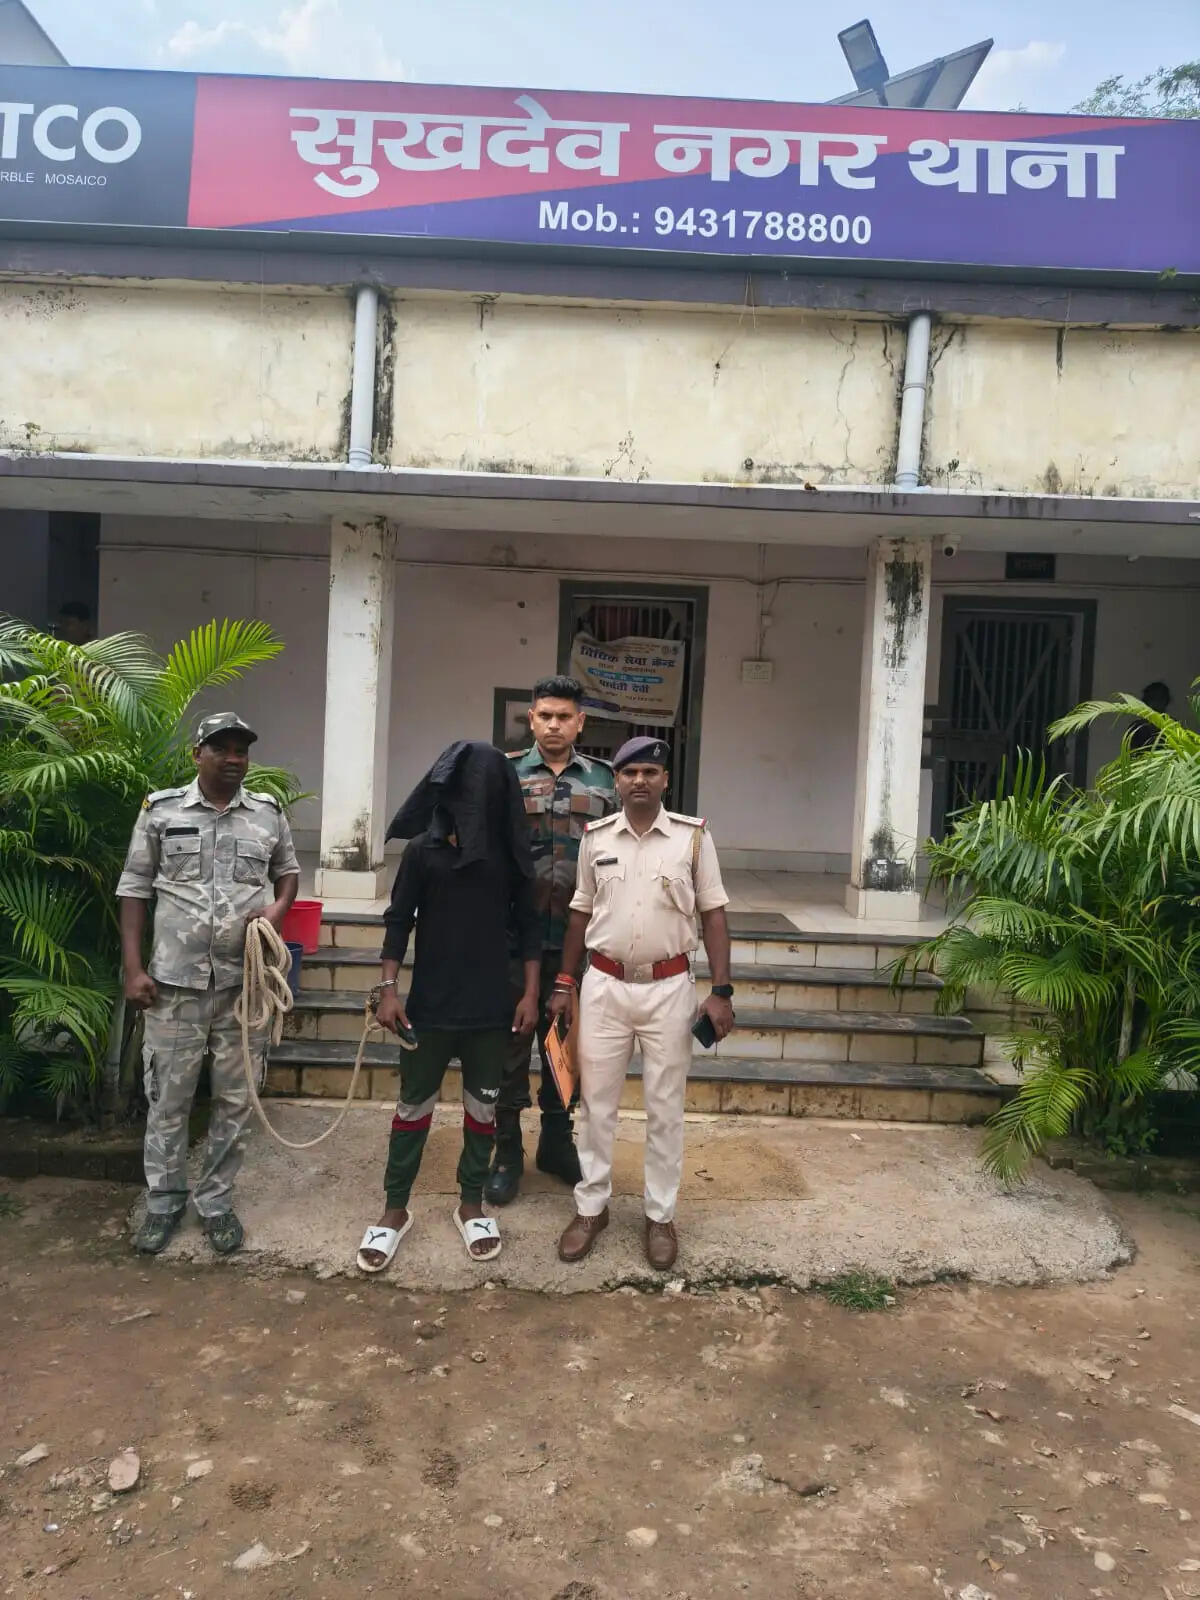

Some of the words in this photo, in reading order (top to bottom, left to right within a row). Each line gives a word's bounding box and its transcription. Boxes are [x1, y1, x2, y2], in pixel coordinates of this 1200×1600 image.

[289, 95, 630, 198] सुखदेव
[653, 124, 888, 190] नगर
[908, 138, 1124, 199] थाना
[45, 173, 107, 186] MOSAICO
[538, 200, 640, 235] Mob.:
[653, 206, 872, 245] 9431788800
